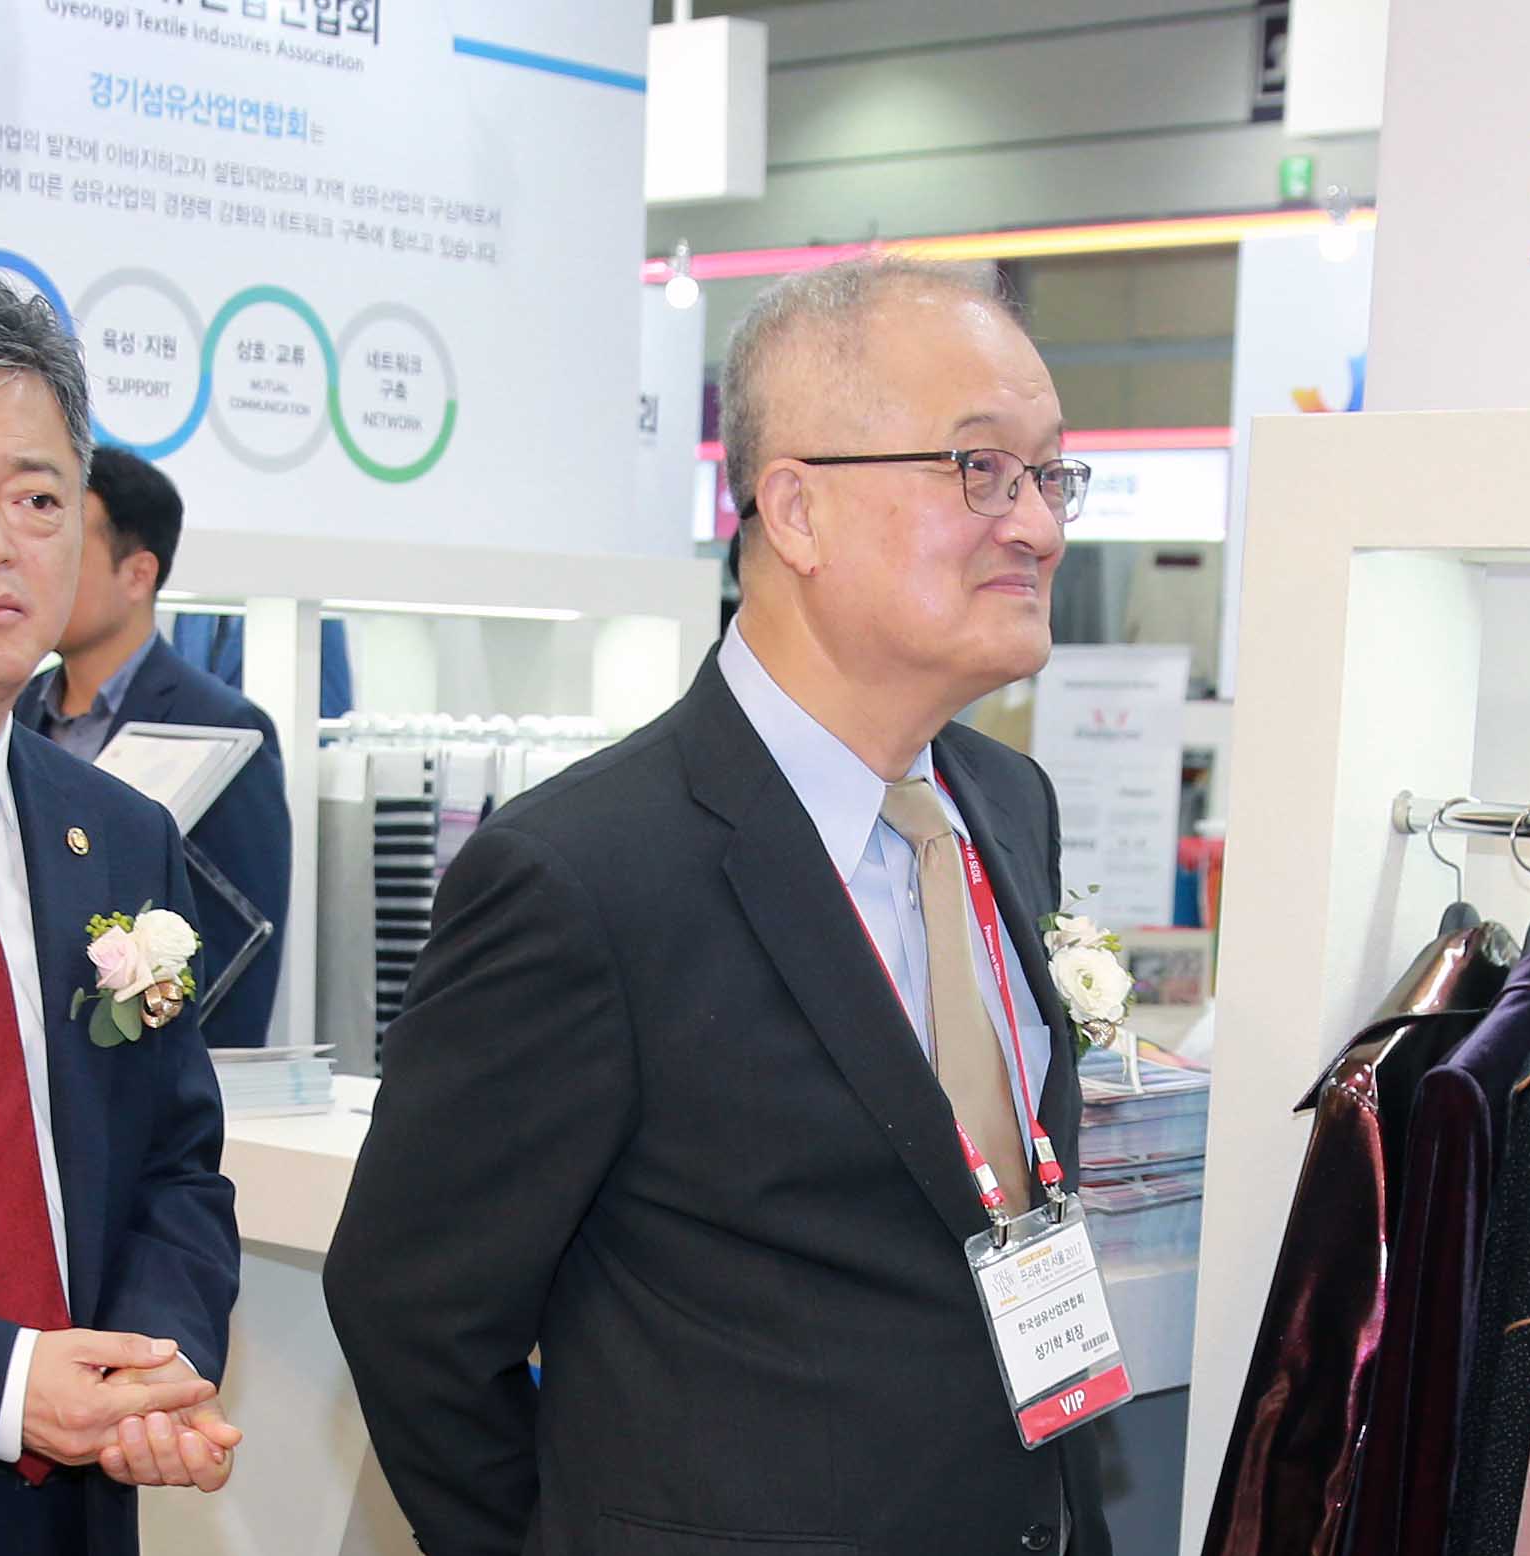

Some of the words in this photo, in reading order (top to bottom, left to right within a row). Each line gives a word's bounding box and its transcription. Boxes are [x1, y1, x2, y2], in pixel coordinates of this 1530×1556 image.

[135, 9, 189, 38] Textile
[193, 24, 272, 55] Industries
[276, 40, 366, 73] Association
[88, 70, 325, 145] 경기섬유산업연합회는
[46, 132, 100, 163] 발전에
[28, 172, 65, 199] 따른
[71, 179, 156, 214] 섬유산업의
[366, 350, 424, 376] 네트워크
[106, 376, 171, 399] SUPPORT
[361, 411, 424, 433] NETWORK
[1059, 1389, 1086, 1417] VIP
